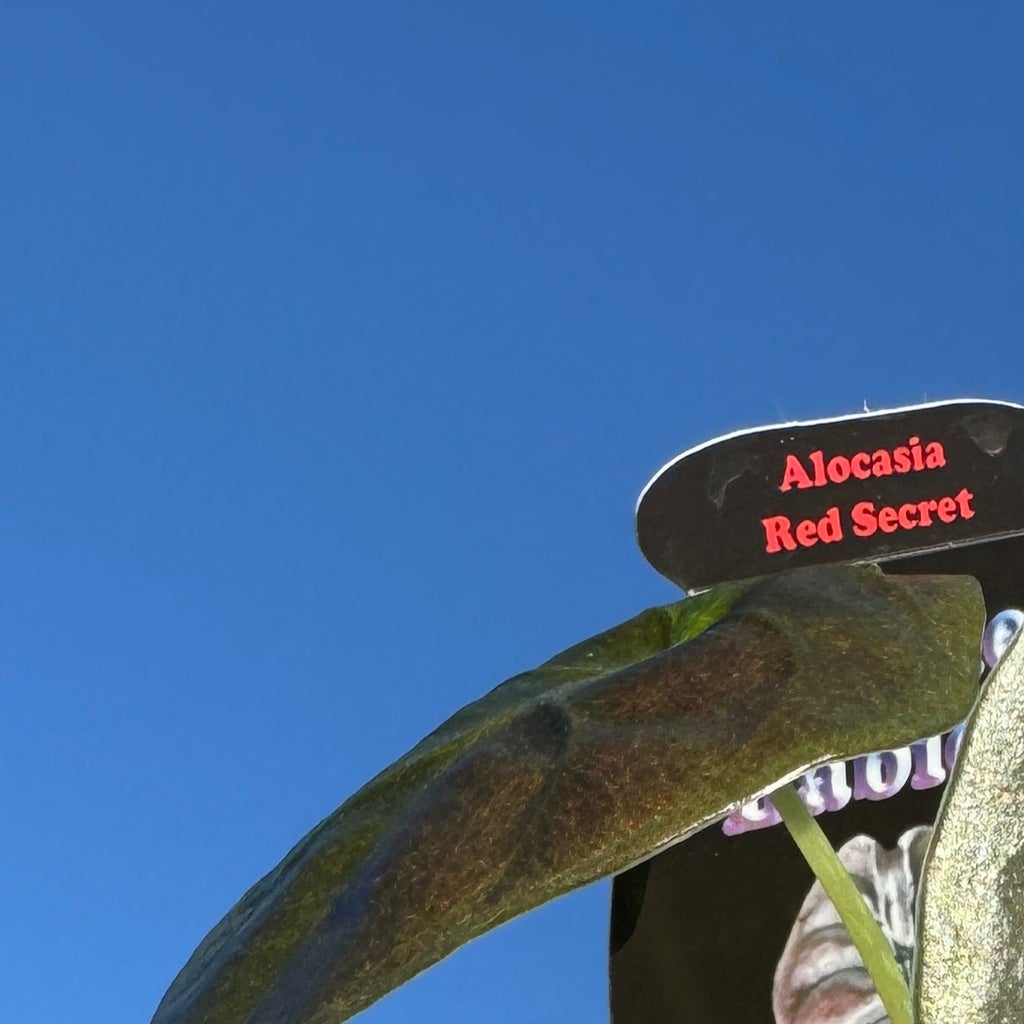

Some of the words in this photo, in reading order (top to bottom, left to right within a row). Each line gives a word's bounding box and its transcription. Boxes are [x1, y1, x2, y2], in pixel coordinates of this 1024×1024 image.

[779, 436, 946, 492] Alocasia
[762, 507, 843, 553] Red
[851, 488, 975, 537] Secret
